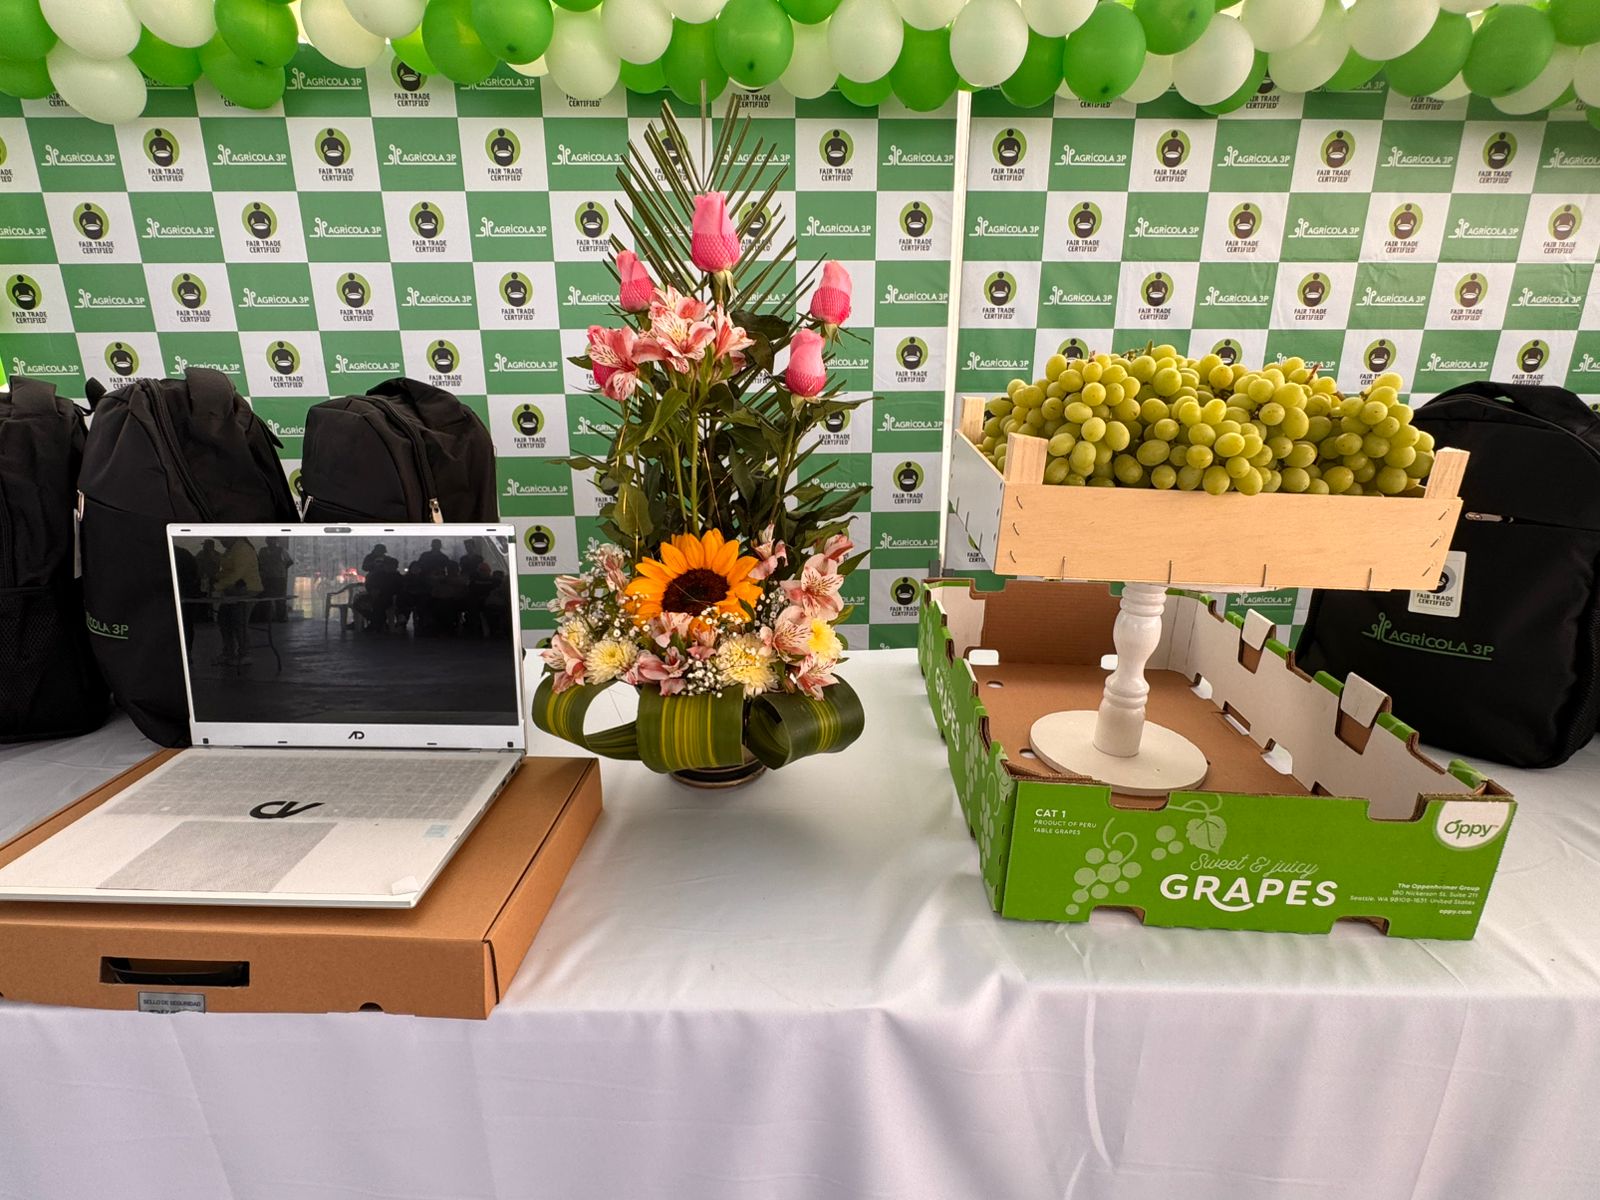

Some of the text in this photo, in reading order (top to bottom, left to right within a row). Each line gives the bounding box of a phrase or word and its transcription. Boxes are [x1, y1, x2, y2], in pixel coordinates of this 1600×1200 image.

[104, 154, 115, 162] 3P
[276, 154, 287, 162] 3P
[446, 154, 457, 162] 3P
[944, 153, 955, 161] 3P
[1116, 154, 1127, 162] 3P
[1279, 155, 1291, 163] 3P
[371, 226, 382, 234] 3P
[536, 226, 547, 234] 3P
[1029, 225, 1040, 233] 3P
[1189, 226, 1200, 234] 3P
[1507, 227, 1520, 235] 3P
[134, 297, 145, 305] 3P
[1102, 294, 1113, 302] 3P
[1418, 598, 1451, 607] CERTIFIED
[111, 623, 129, 635] 3P
[1472, 643, 1495, 656] 3P
[1035, 808, 1067, 818] CAT 1
[1033, 819, 1066, 827] PRODUCT
[1190, 853, 1319, 879] Sweet & juicy
[1411, 883, 1458, 891] Oppenheimer
[1159, 873, 1338, 912] GRAPES
